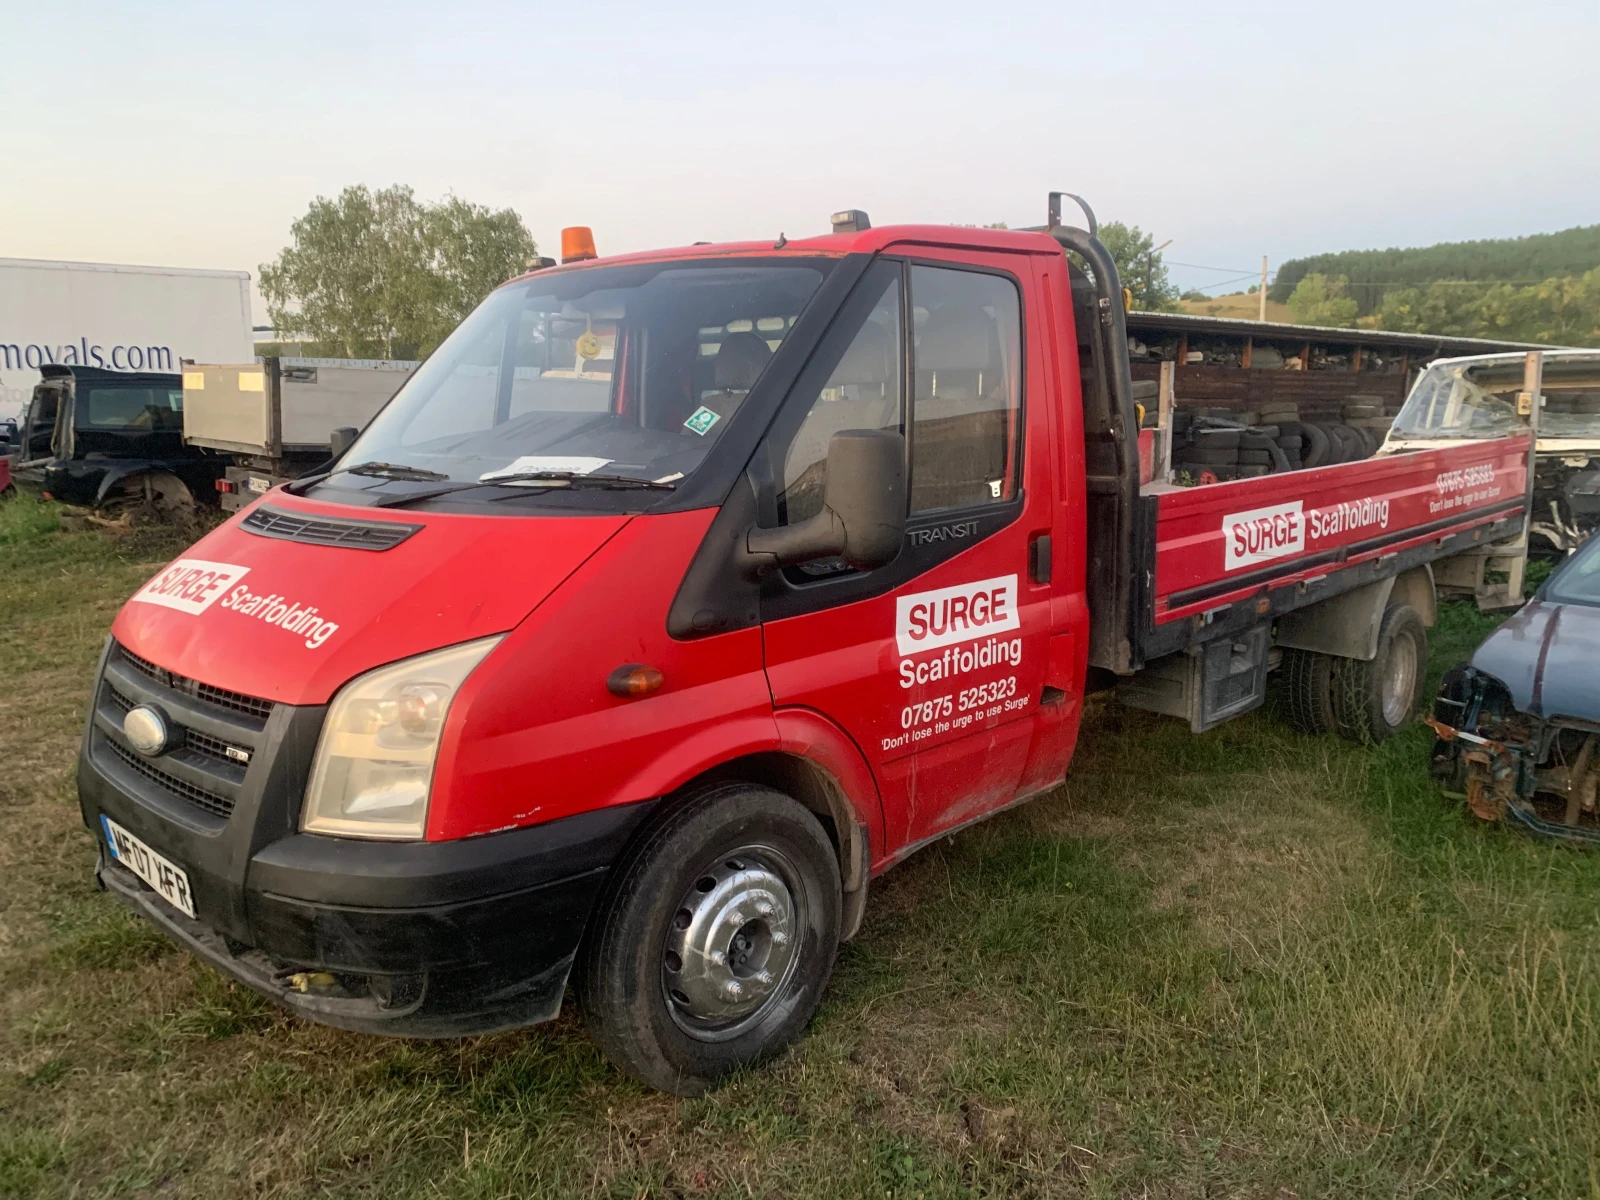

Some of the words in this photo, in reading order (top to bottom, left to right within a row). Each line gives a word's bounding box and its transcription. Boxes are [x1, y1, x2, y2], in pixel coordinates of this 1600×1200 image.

[906, 521, 979, 546] TRANSIT
[1232, 511, 1298, 558] SURGE
[1310, 497, 1389, 539] Scaffolding
[149, 566, 231, 604] SURGE
[220, 584, 340, 649] Scaffolding
[908, 587, 1008, 641] SURGE
[899, 638, 1022, 689] Scaffolding
[901, 695, 953, 729] 07875
[958, 676, 1017, 712] 525323
[911, 726, 933, 742] lose
[935, 721, 950, 734] the
[952, 715, 973, 728] urge
[975, 710, 985, 721] to
[987, 705, 1002, 717] use
